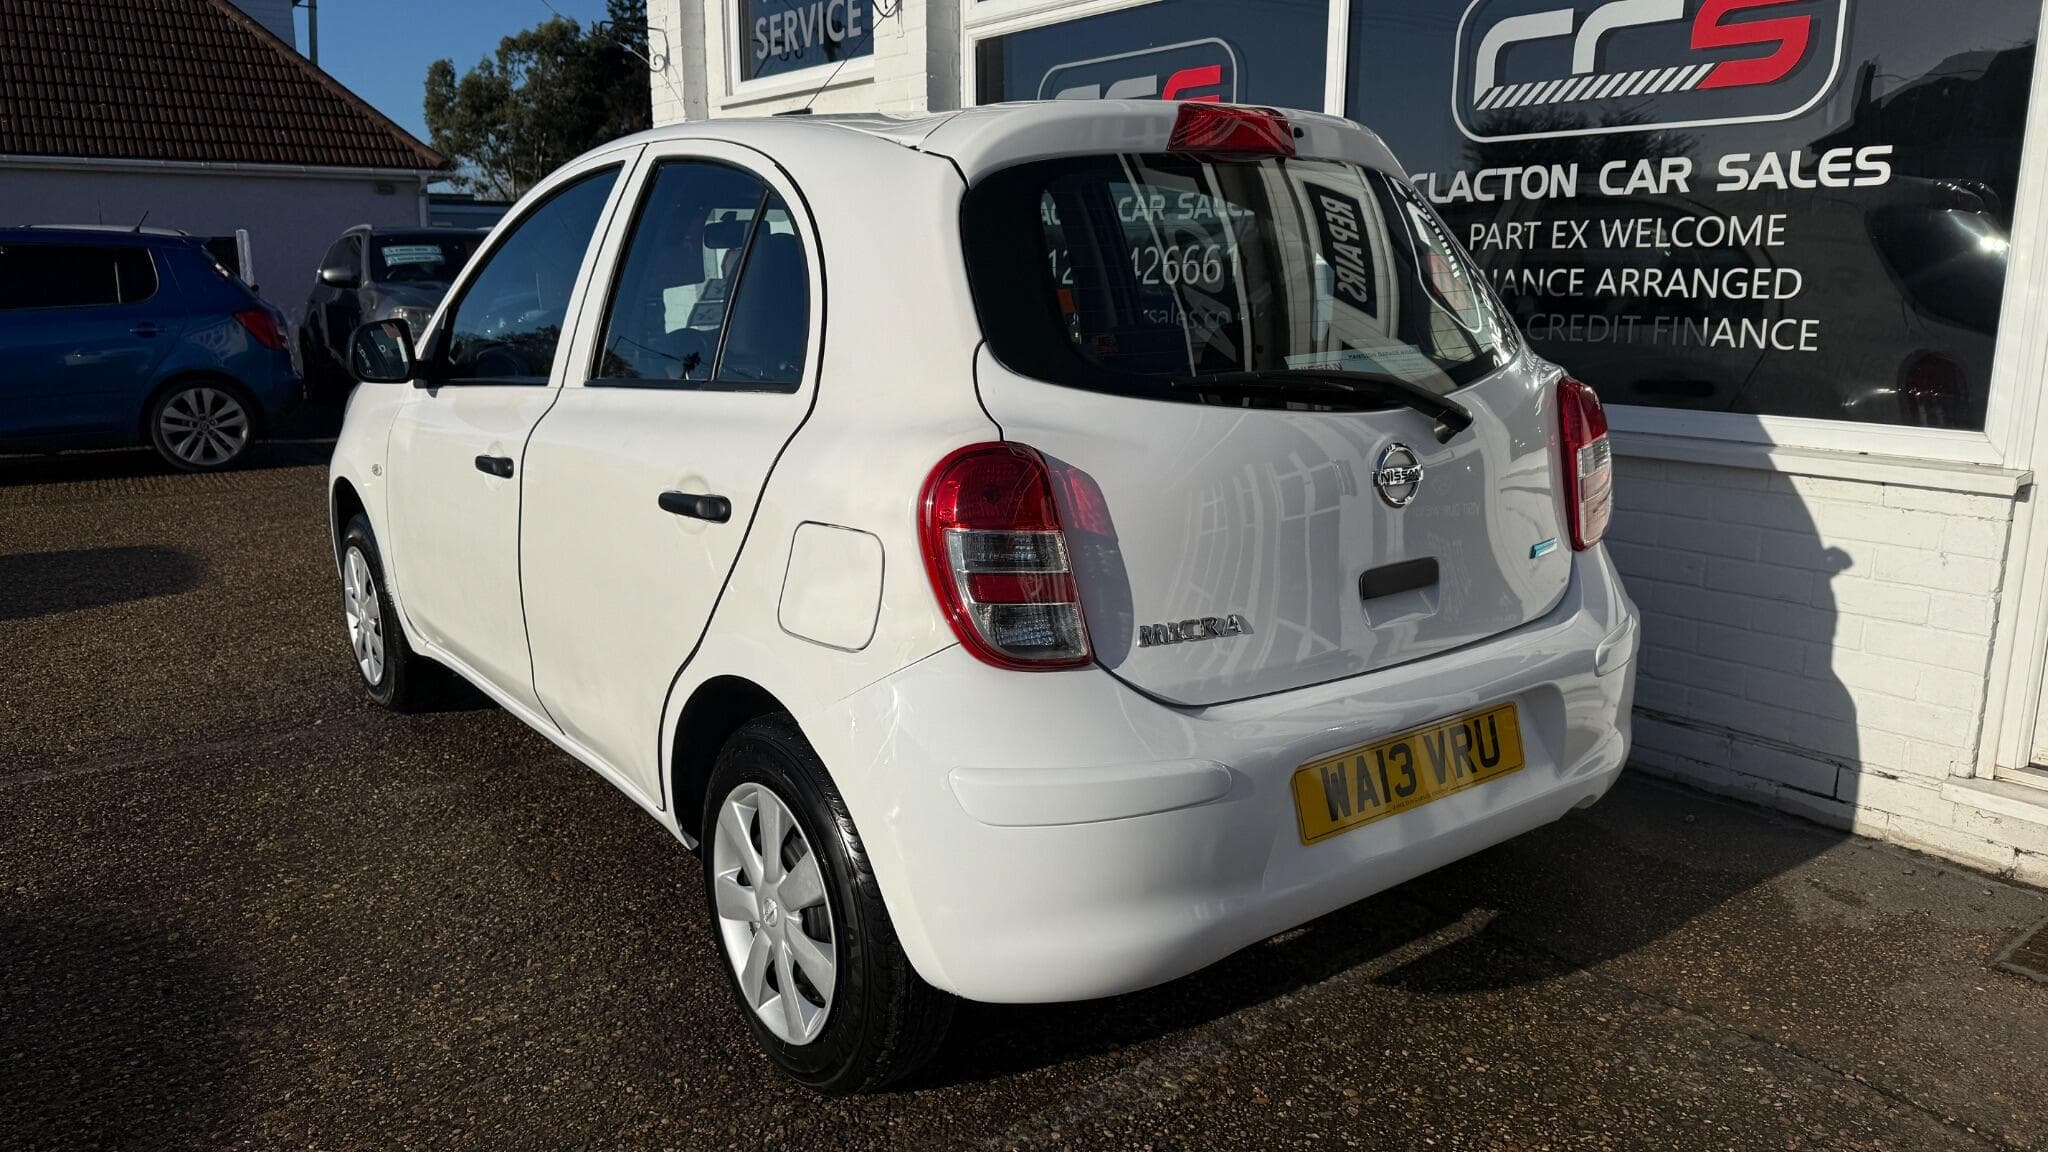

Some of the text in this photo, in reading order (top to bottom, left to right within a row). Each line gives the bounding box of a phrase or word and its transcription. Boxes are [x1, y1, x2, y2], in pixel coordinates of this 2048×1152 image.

[755, 0, 861, 60] SERVICE
[1600, 159, 1692, 195] CAR
[1717, 145, 1893, 192] SALES
[1118, 194, 1165, 222] CAR
[1469, 213, 1786, 251] PART EX WELCOME
[1594, 268, 1802, 300] ARRANGED
[1526, 313, 1820, 352] CREDIT FINANCE
[1380, 467, 1420, 484] NISSAN
[1137, 614, 1243, 648] MICRA
[1320, 715, 1500, 822] WA13 VRU
